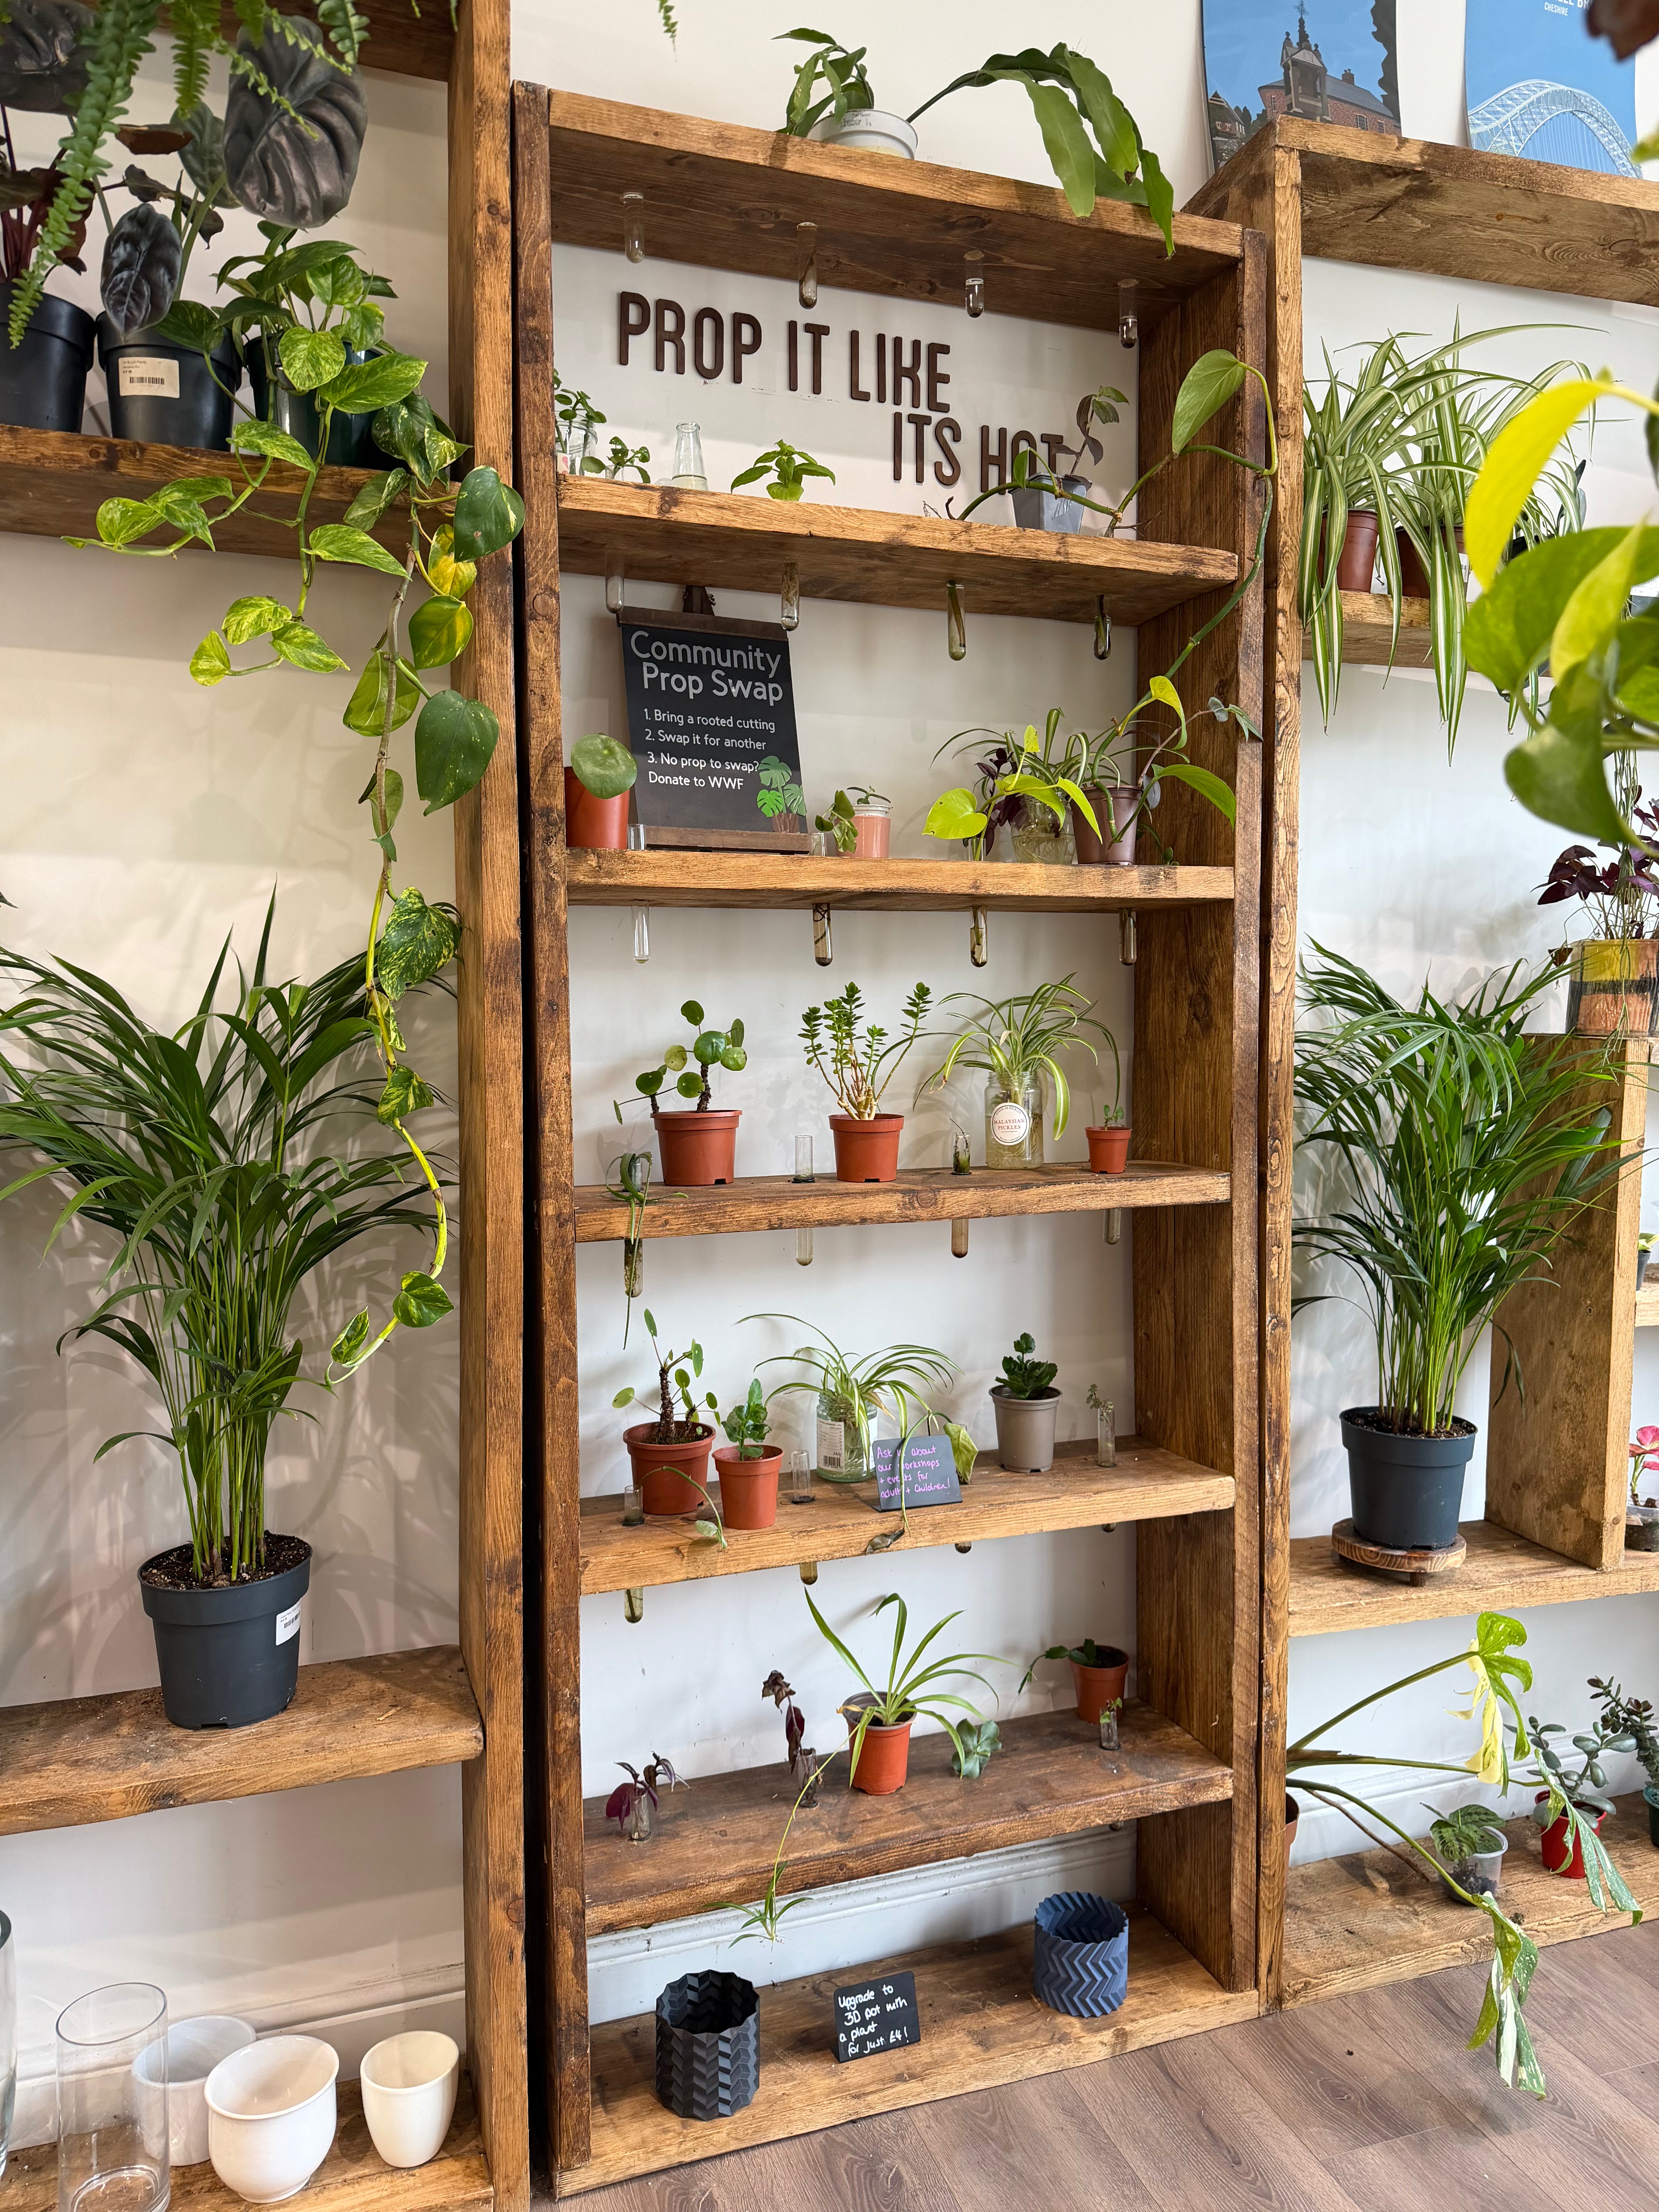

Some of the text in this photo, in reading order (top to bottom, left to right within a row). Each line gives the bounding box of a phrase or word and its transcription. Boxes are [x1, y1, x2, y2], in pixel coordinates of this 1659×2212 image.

[1544, 2, 1568, 16] CHESHIRE
[620, 291, 950, 412] PROP IT LIKE
[893, 412, 1063, 495] ITS HOT
[630, 631, 781, 678] Community
[642, 662, 783, 706] Prop Swap
[644, 709, 775, 733] 1. Bring a rooted cutting
[645, 729, 766, 750] 2. Swap it for another
[648, 752, 759, 773] 3. No prop to swap?
[649, 772, 744, 790] Donate to WWF
[877, 1446, 893, 1459] Ask
[912, 1445, 936, 1456] about
[878, 1464, 892, 1472] our
[887, 1474, 912, 1484] evets
[917, 1471, 928, 1482] for
[838, 1984, 893, 2010] Upgrade to
[844, 1996, 907, 2026] 3D pot with
[840, 2021, 878, 2042] a plant
[848, 2042, 859, 2057] for
